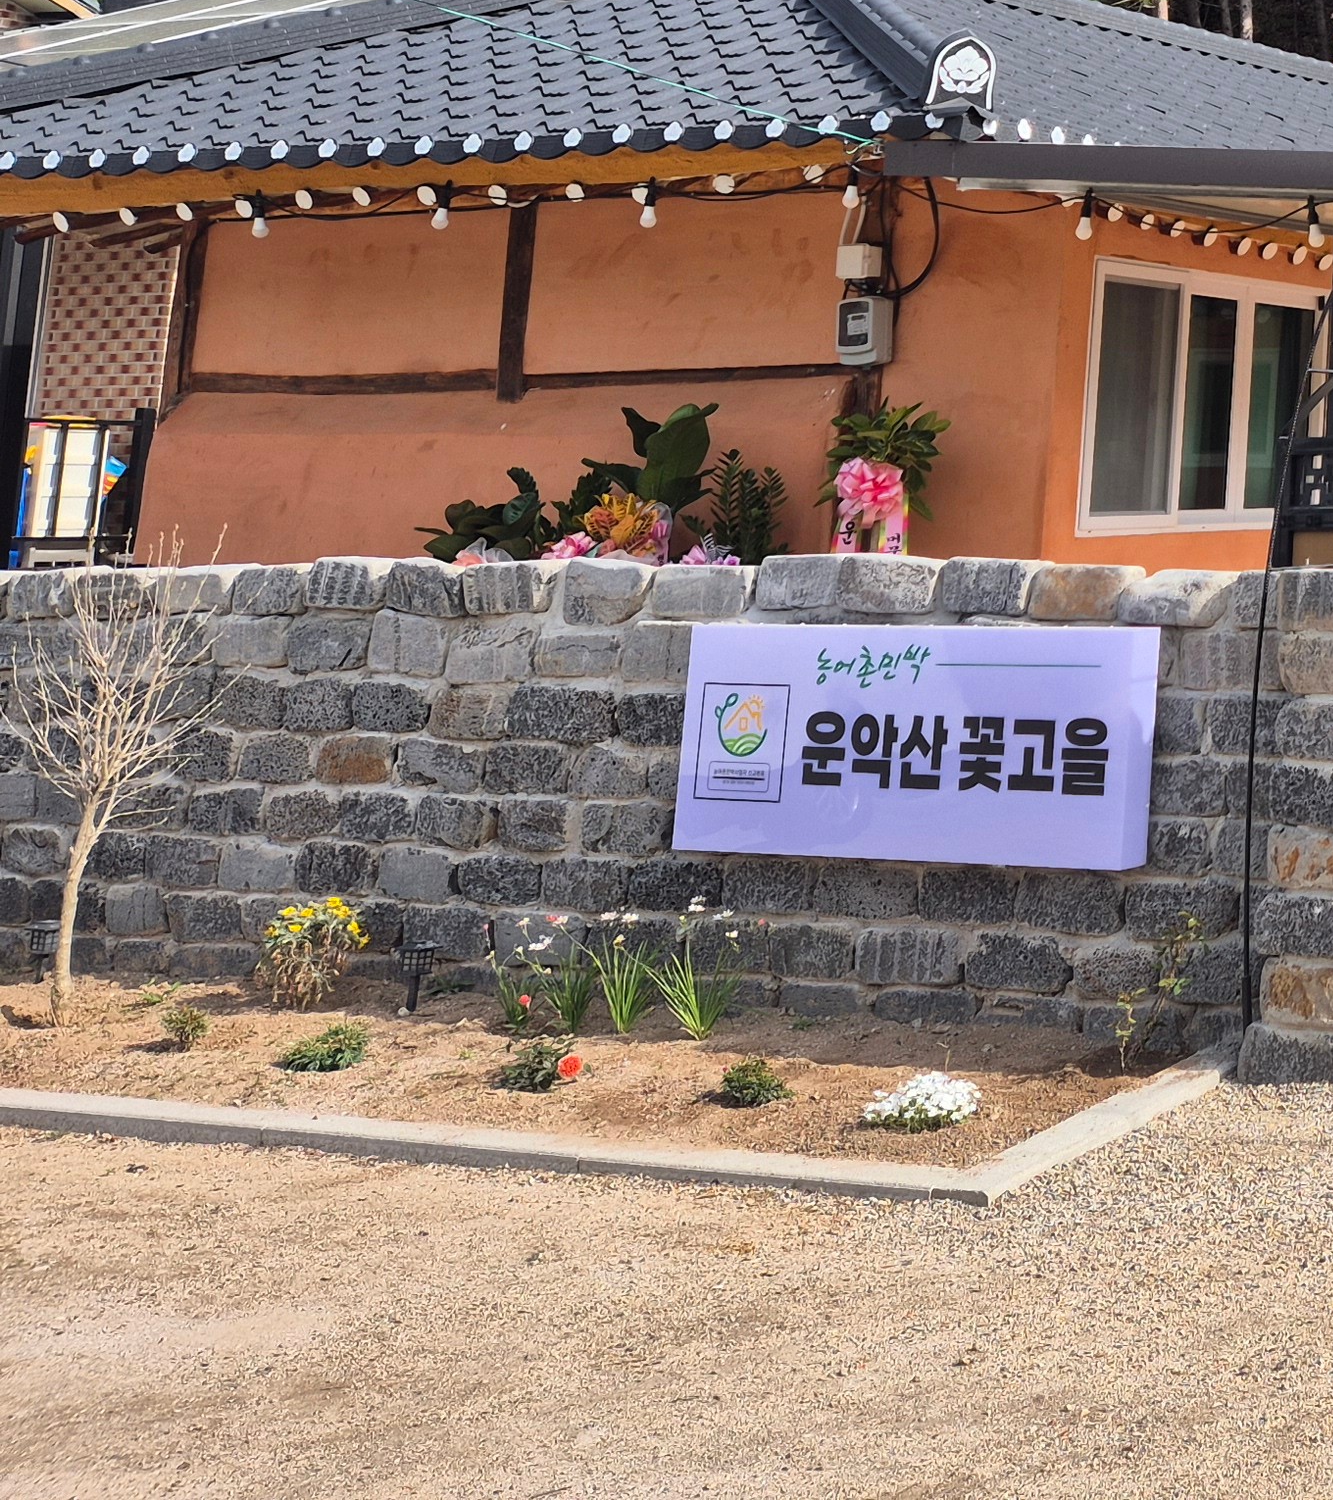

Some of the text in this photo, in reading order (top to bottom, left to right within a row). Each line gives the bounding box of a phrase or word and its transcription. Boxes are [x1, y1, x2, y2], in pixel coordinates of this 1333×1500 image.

[816, 644, 931, 689] 농어촌민박
[801, 710, 1109, 796] 운악산 꽃고을
